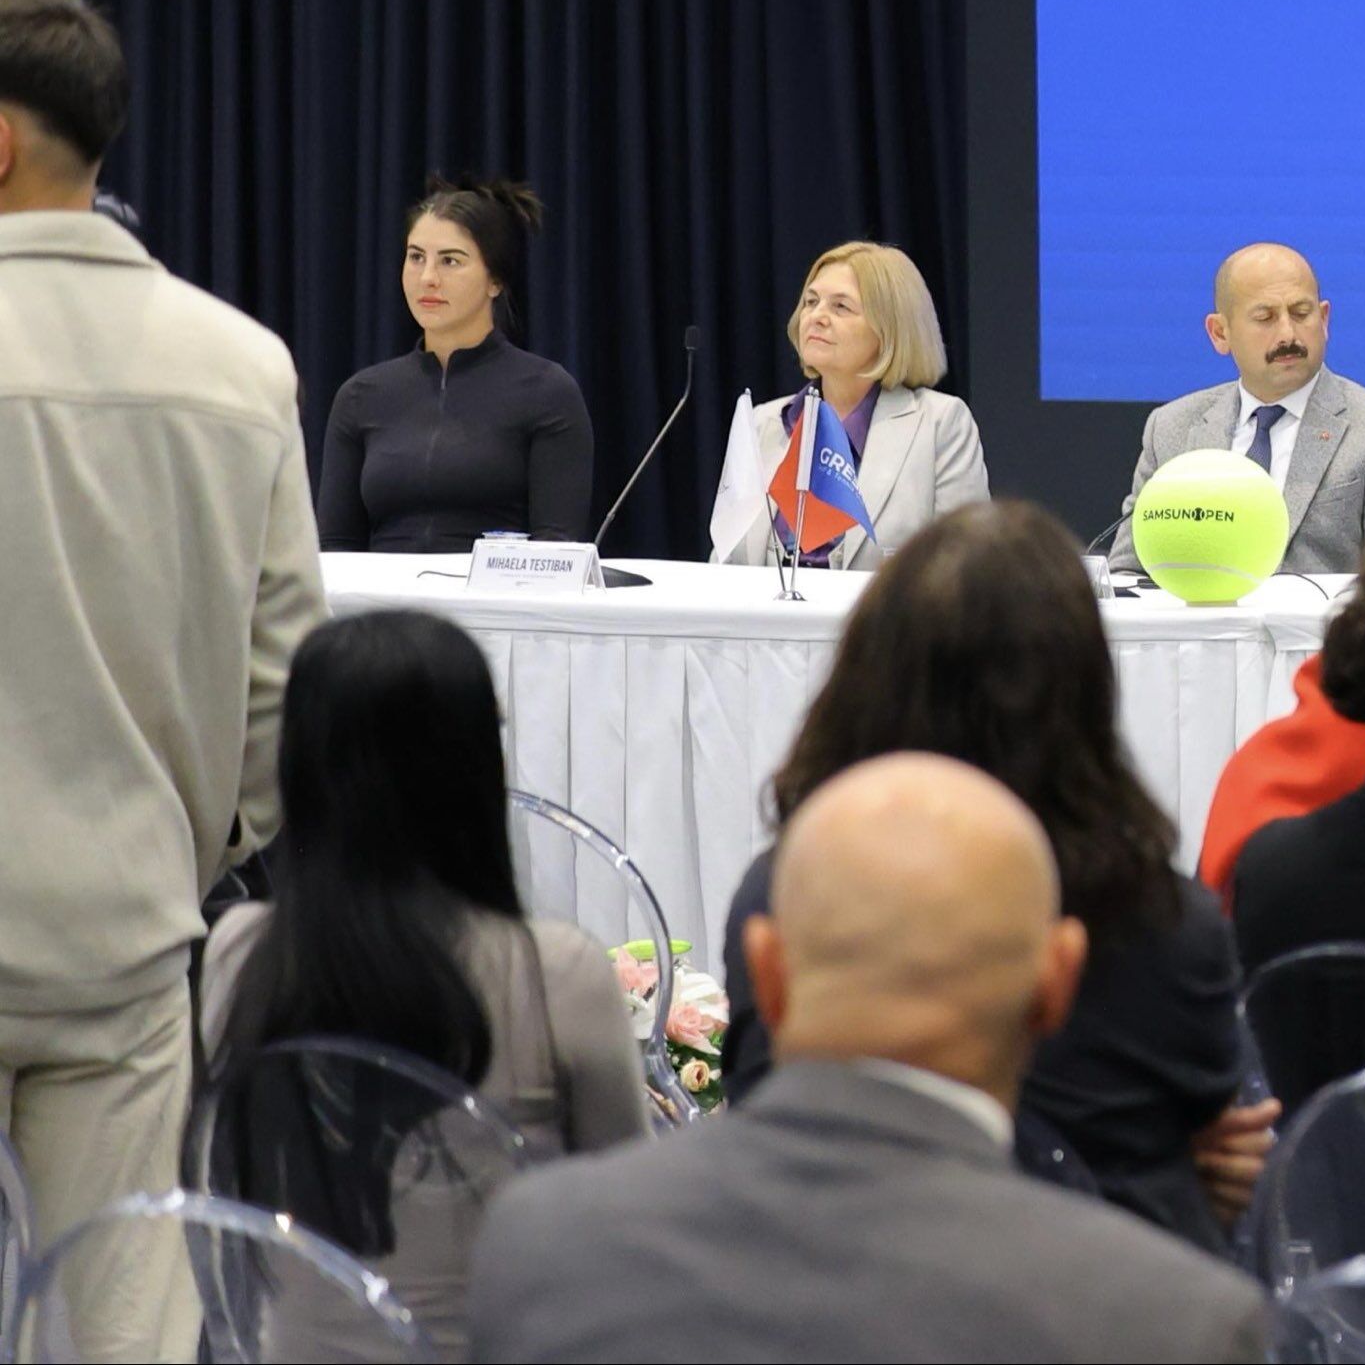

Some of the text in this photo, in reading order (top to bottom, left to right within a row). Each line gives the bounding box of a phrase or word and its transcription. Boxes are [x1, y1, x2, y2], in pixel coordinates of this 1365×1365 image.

[1143, 507, 1235, 522] SAMSUNOPEN
[486, 557, 574, 572] MIHAELA TESTIBAN
